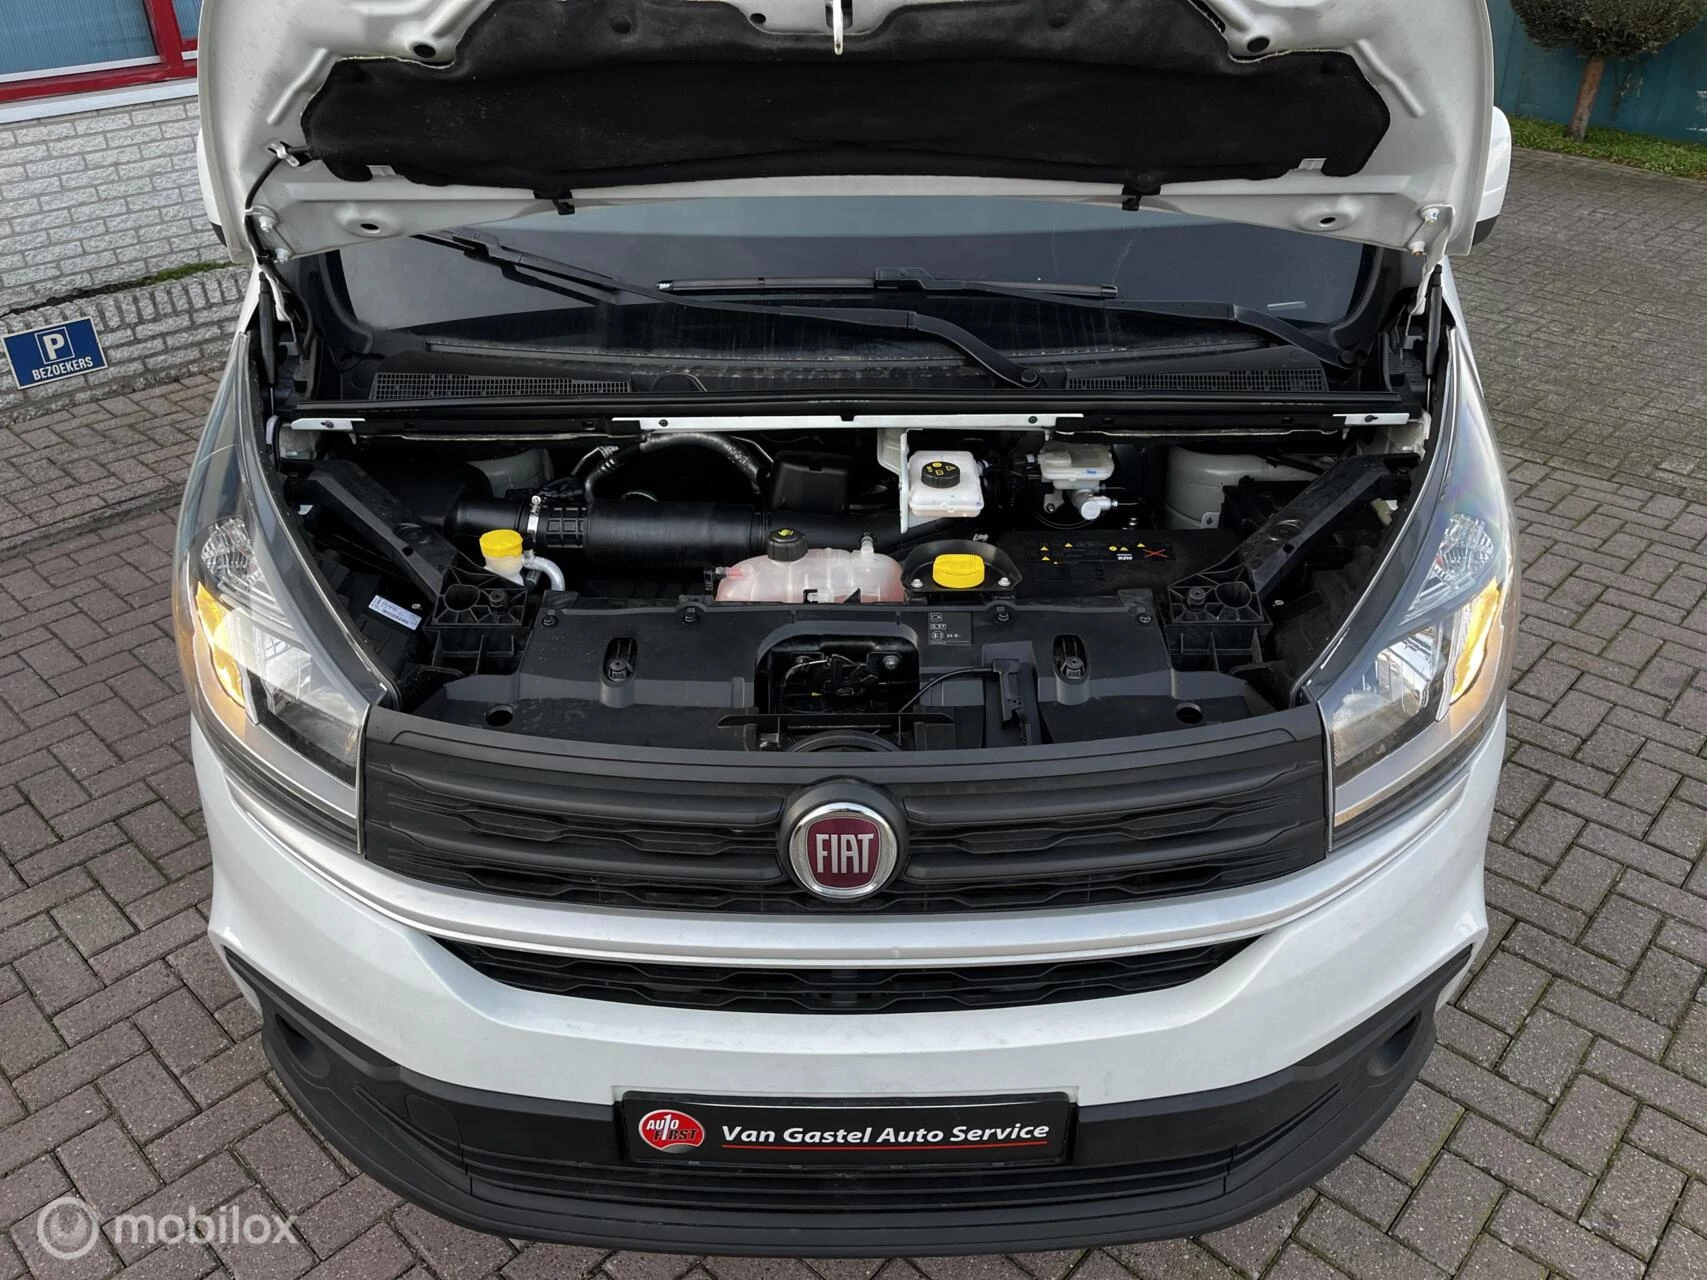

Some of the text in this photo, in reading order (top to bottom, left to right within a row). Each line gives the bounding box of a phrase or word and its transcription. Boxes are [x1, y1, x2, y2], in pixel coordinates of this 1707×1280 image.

[43, 333, 65, 360] P
[32, 356, 94, 381] BEZOEKERS
[816, 833, 875, 874] FIAT
[722, 1123, 1050, 1143] Van Gastel Auto Service
